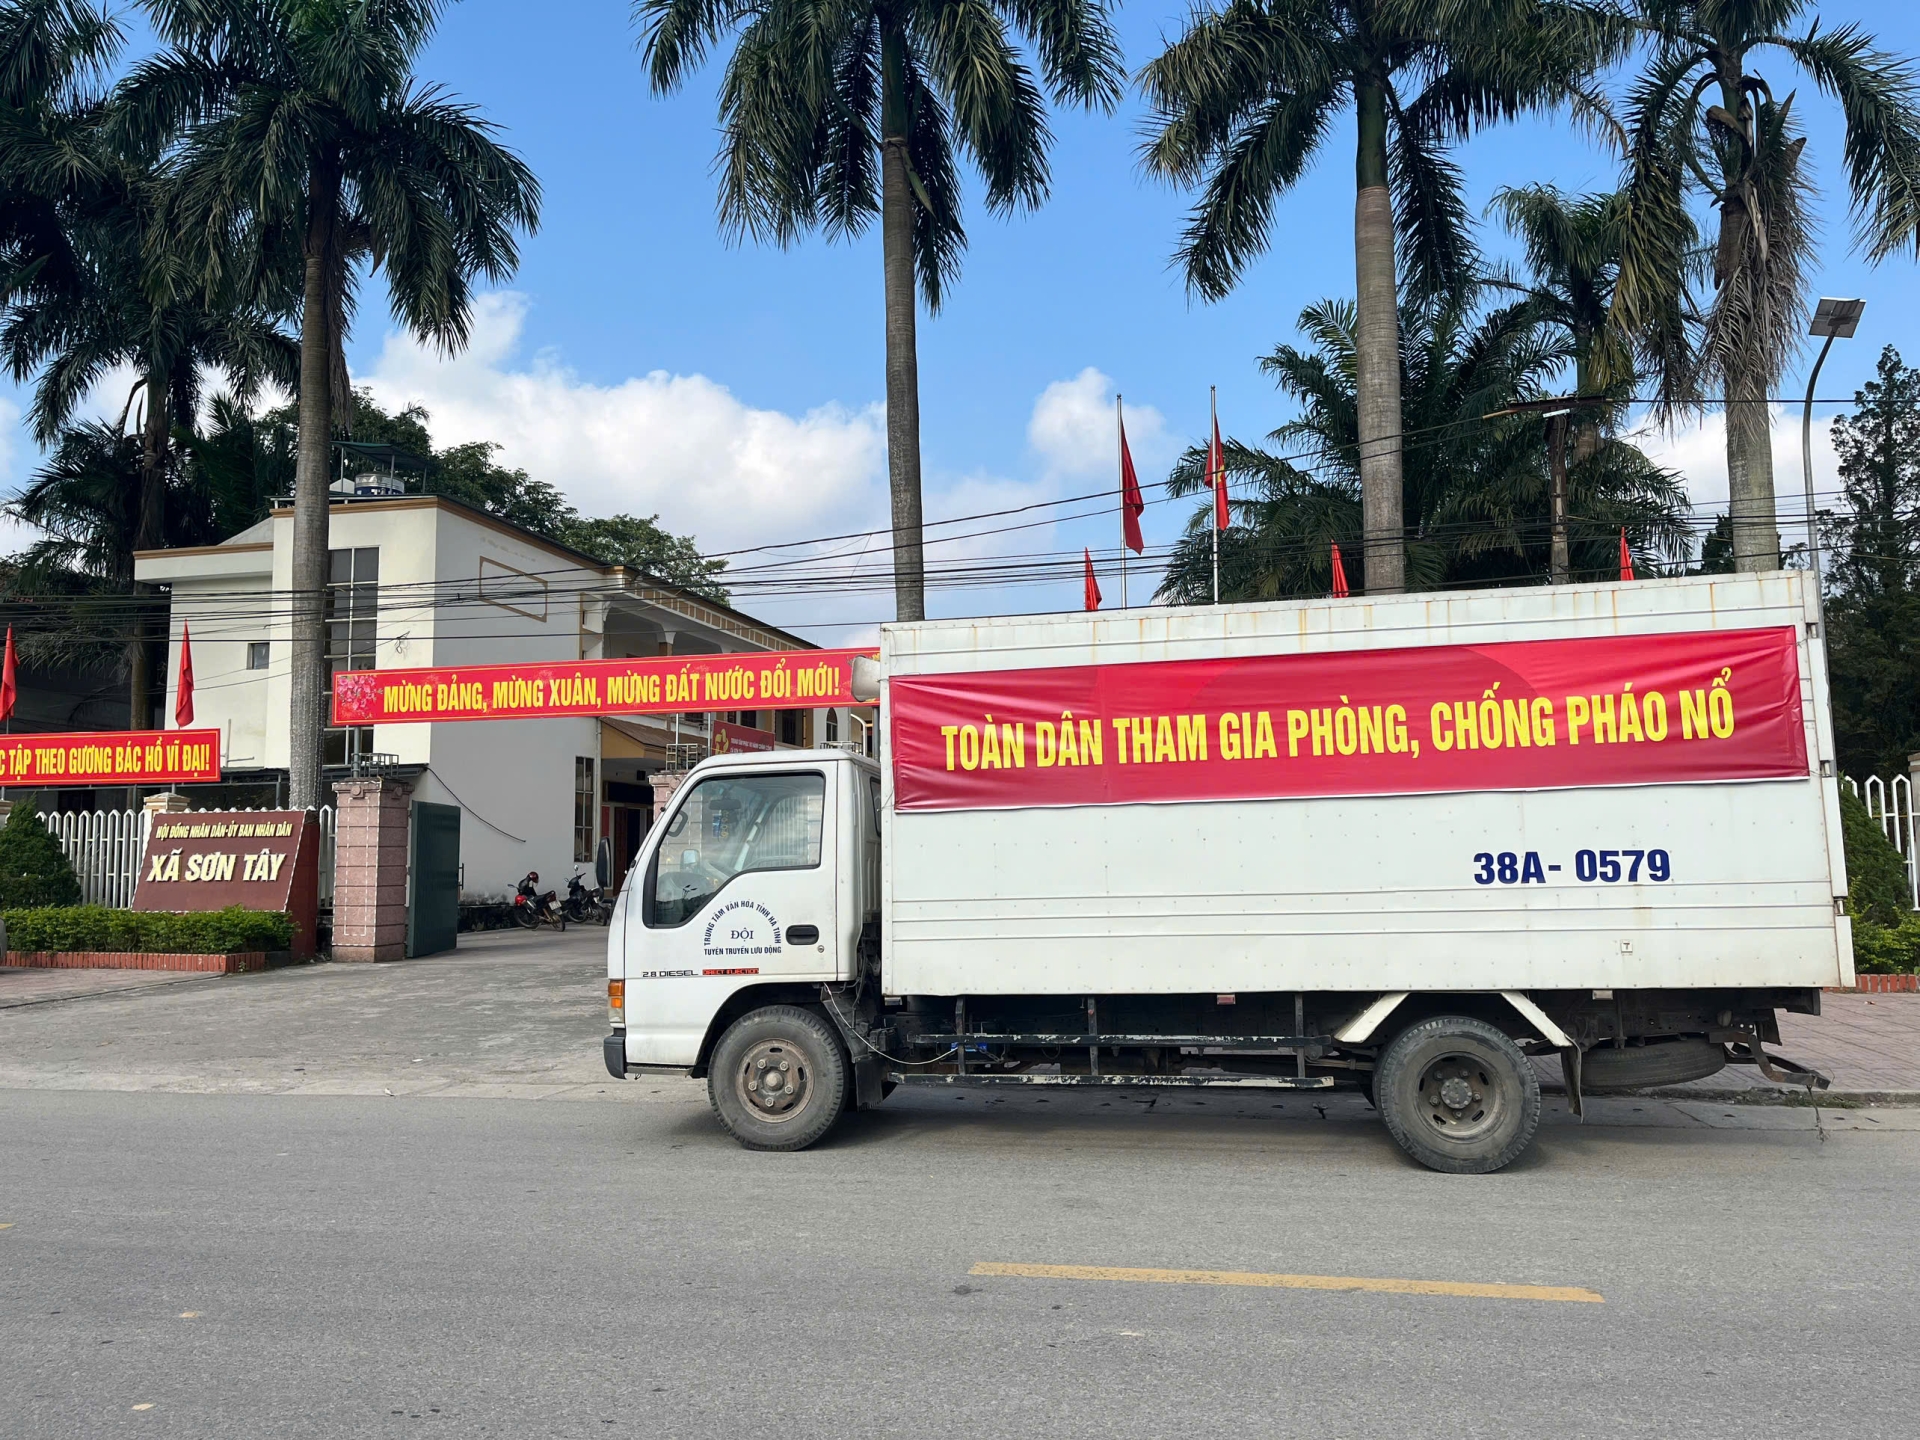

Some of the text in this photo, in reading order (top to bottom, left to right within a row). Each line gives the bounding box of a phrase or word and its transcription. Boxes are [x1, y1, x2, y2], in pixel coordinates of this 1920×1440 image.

[384, 658, 840, 713] MỪNG ĐẢNG, MỪNG XUÂN, MỪNG ĐẤT NƯỚC ĐỔI MỚI!
[941, 666, 1736, 771] TOÀN DÂN THAM GIA PHÒNG, CHỐNG PHÁO NỔ
[8, 743, 32, 781] TẬP
[35, 748, 66, 775] THEO
[69, 744, 112, 774] GƯƠNG
[115, 741, 142, 773] BÁC
[145, 736, 163, 773] HỒ
[166, 740, 180, 772] VĨ
[182, 743, 211, 777] ĐẠI!
[155, 823, 170, 841] HỘI
[189, 822, 211, 838] NHÂN
[238, 823, 255, 837] BAN
[254, 821, 277, 837] NHÂN
[275, 821, 293, 837] DÂN
[146, 847, 287, 882] XÃ SƠN TÂY
[1575, 849, 1671, 883] 0579
[703, 922, 715, 946] TRUNG
[730, 927, 754, 942] ĐỘI
[659, 969, 699, 977] DIESEL
